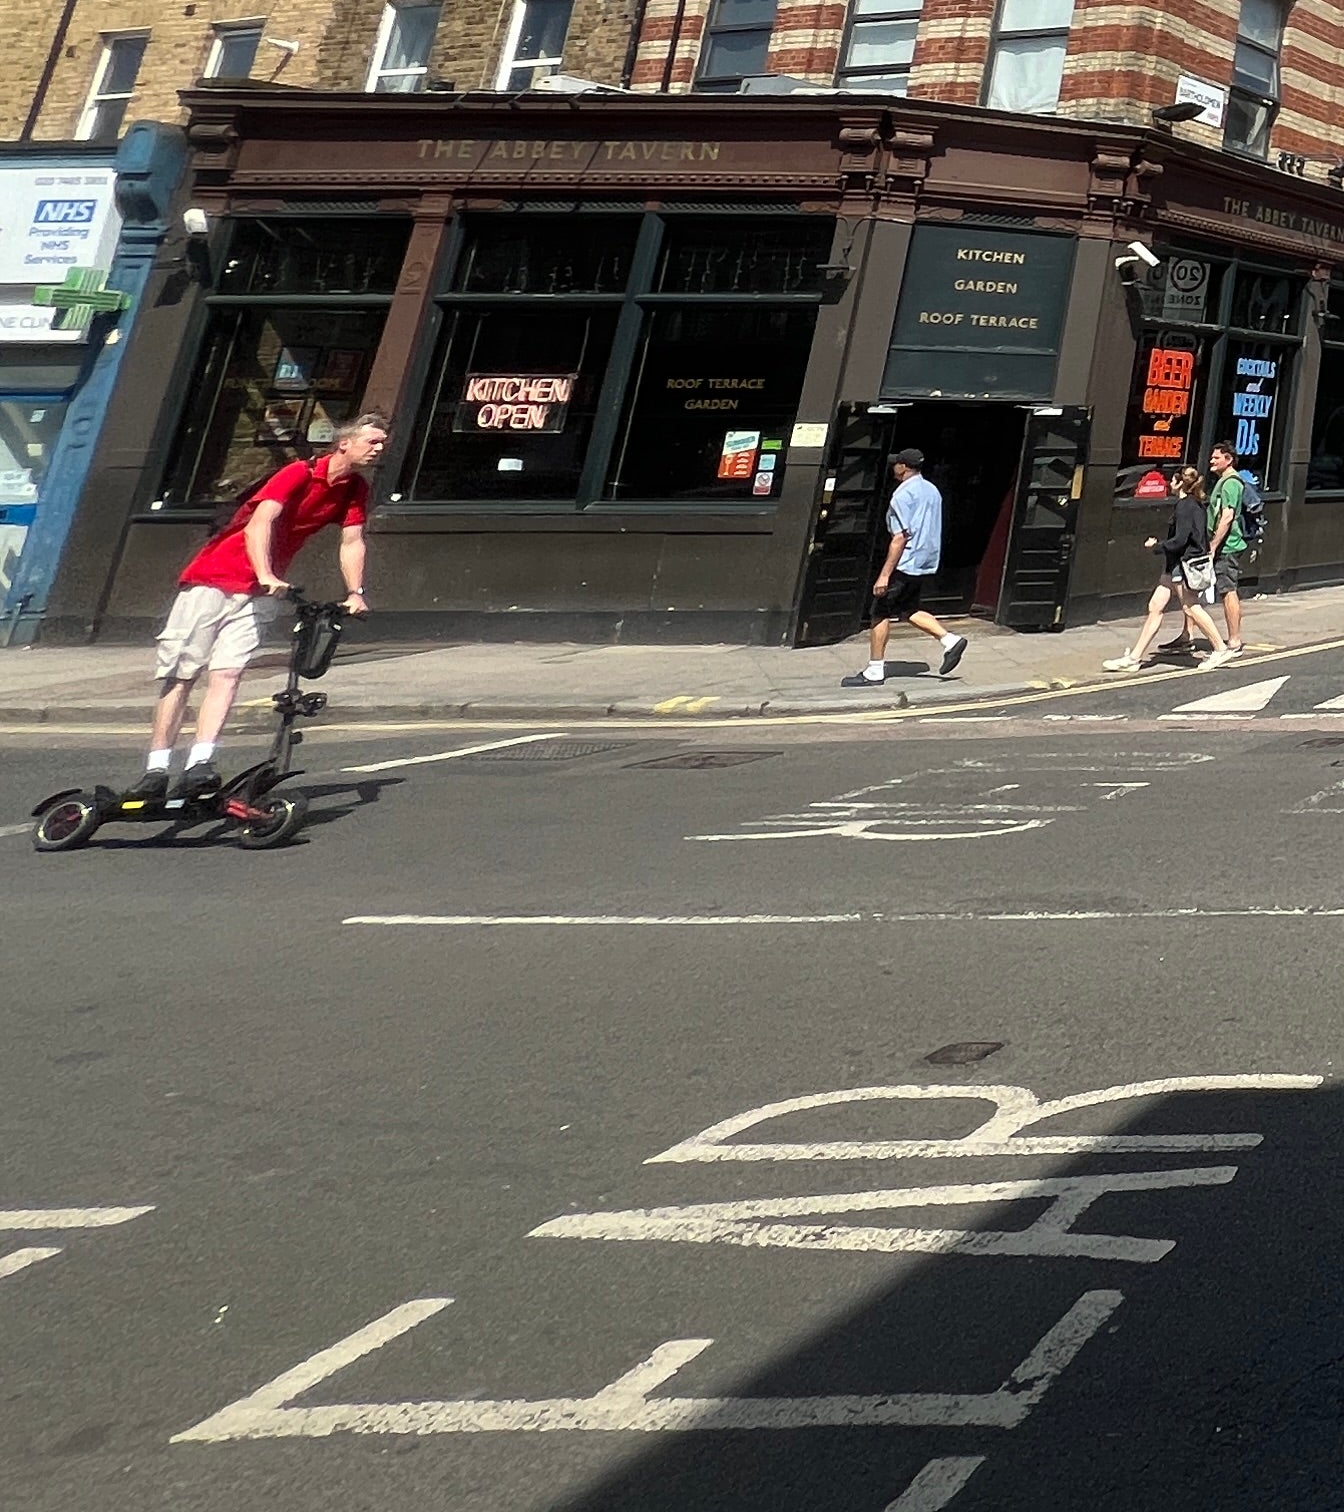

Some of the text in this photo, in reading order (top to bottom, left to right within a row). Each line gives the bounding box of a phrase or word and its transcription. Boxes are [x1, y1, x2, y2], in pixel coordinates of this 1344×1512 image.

[416, 139, 721, 162] THE ABBEY TAVERN
[38, 201, 94, 222] NHS
[1223, 196, 1251, 218] THE
[1256, 205, 1297, 229] ABBEY
[957, 248, 1026, 264] KITCHEN
[954, 279, 1018, 294] GARDEN
[918, 311, 1040, 329] ROOF TERRACE
[1147, 348, 1195, 389] BEER
[466, 377, 571, 403] KITCHEN
[666, 378, 766, 390] ROOF TERRACE
[684, 399, 739, 411] GARDEN
[1143, 388, 1190, 415] GARDEN
[1233, 392, 1273, 418] WEEKLY
[477, 403, 549, 429] OPEN
[1235, 419, 1260, 456] DJs
